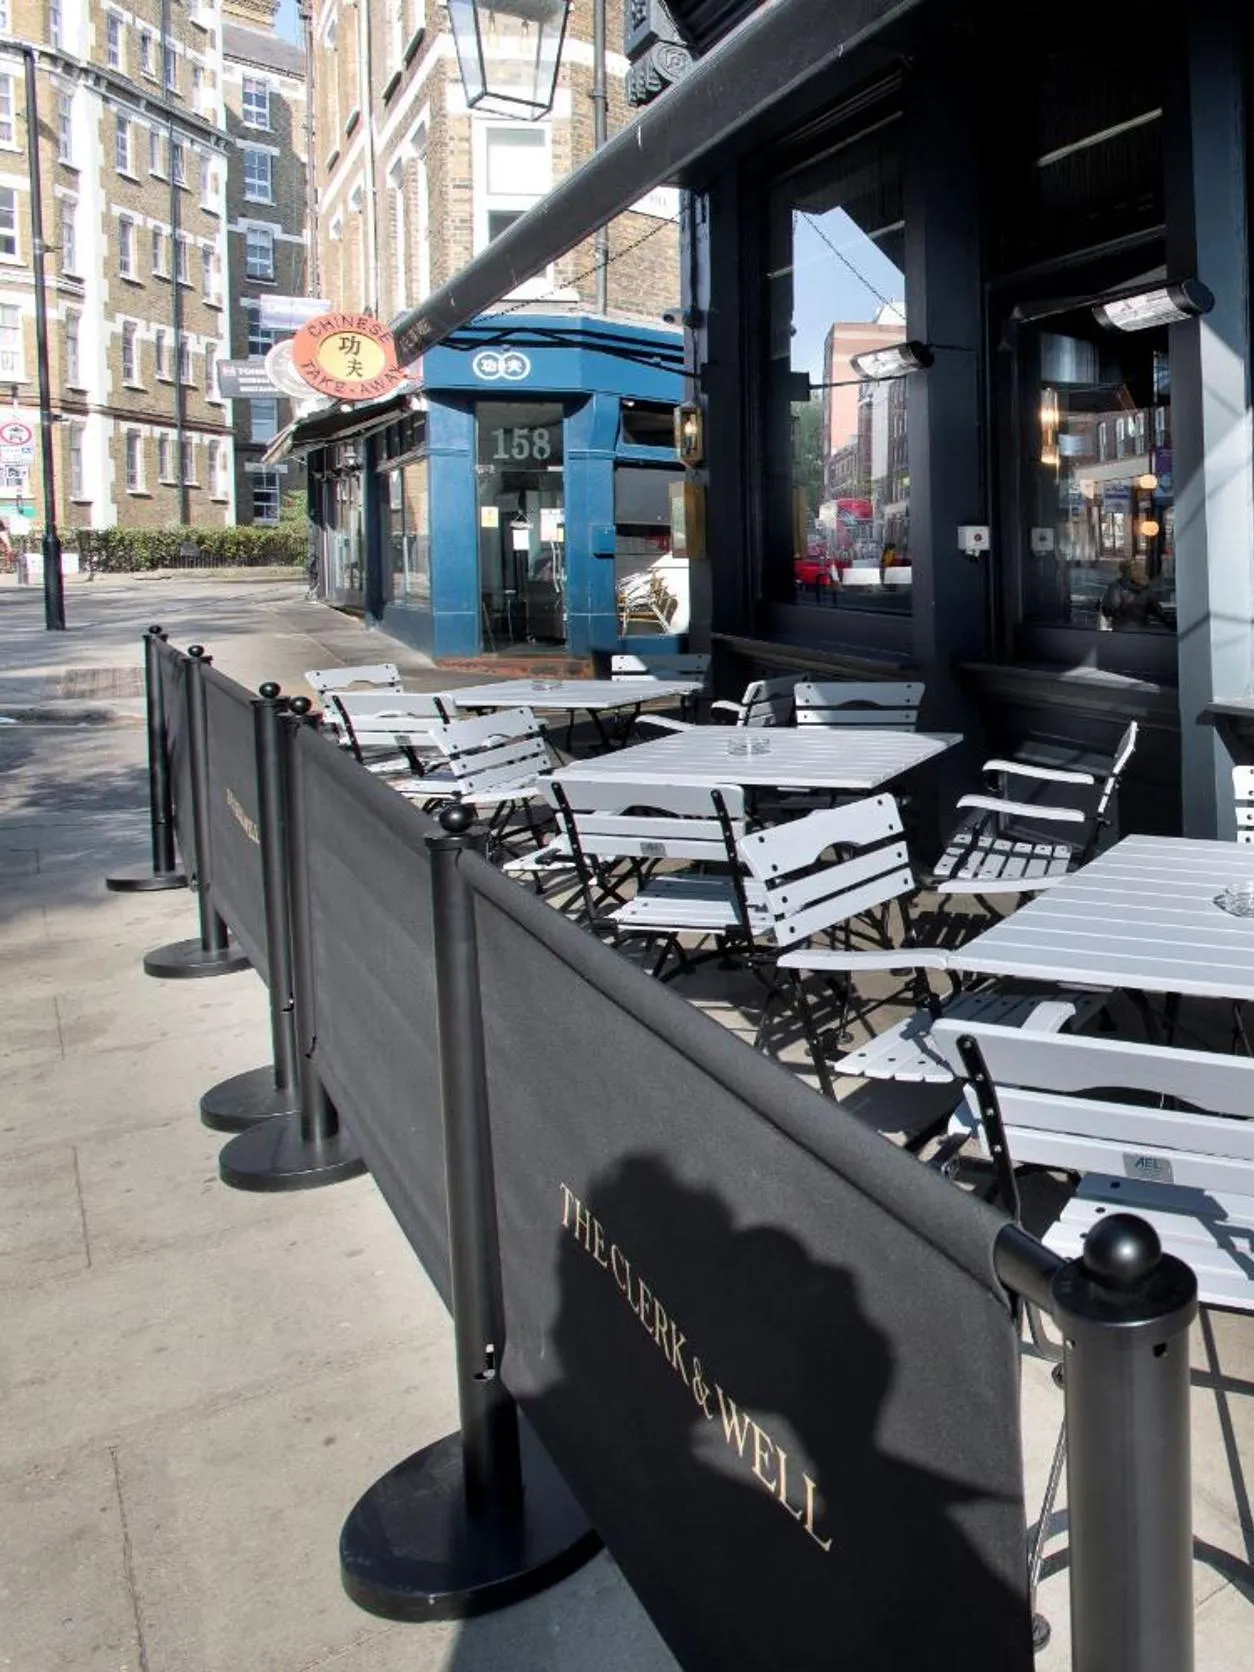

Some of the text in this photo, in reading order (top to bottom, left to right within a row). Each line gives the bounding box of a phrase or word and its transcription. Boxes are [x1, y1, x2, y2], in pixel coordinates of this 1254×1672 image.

[307, 314, 393, 344] CHINESE
[338, 335, 363, 378] 功夫
[492, 427, 552, 461] 158
[559, 1182, 833, 1552] THE CLERK & WELL
